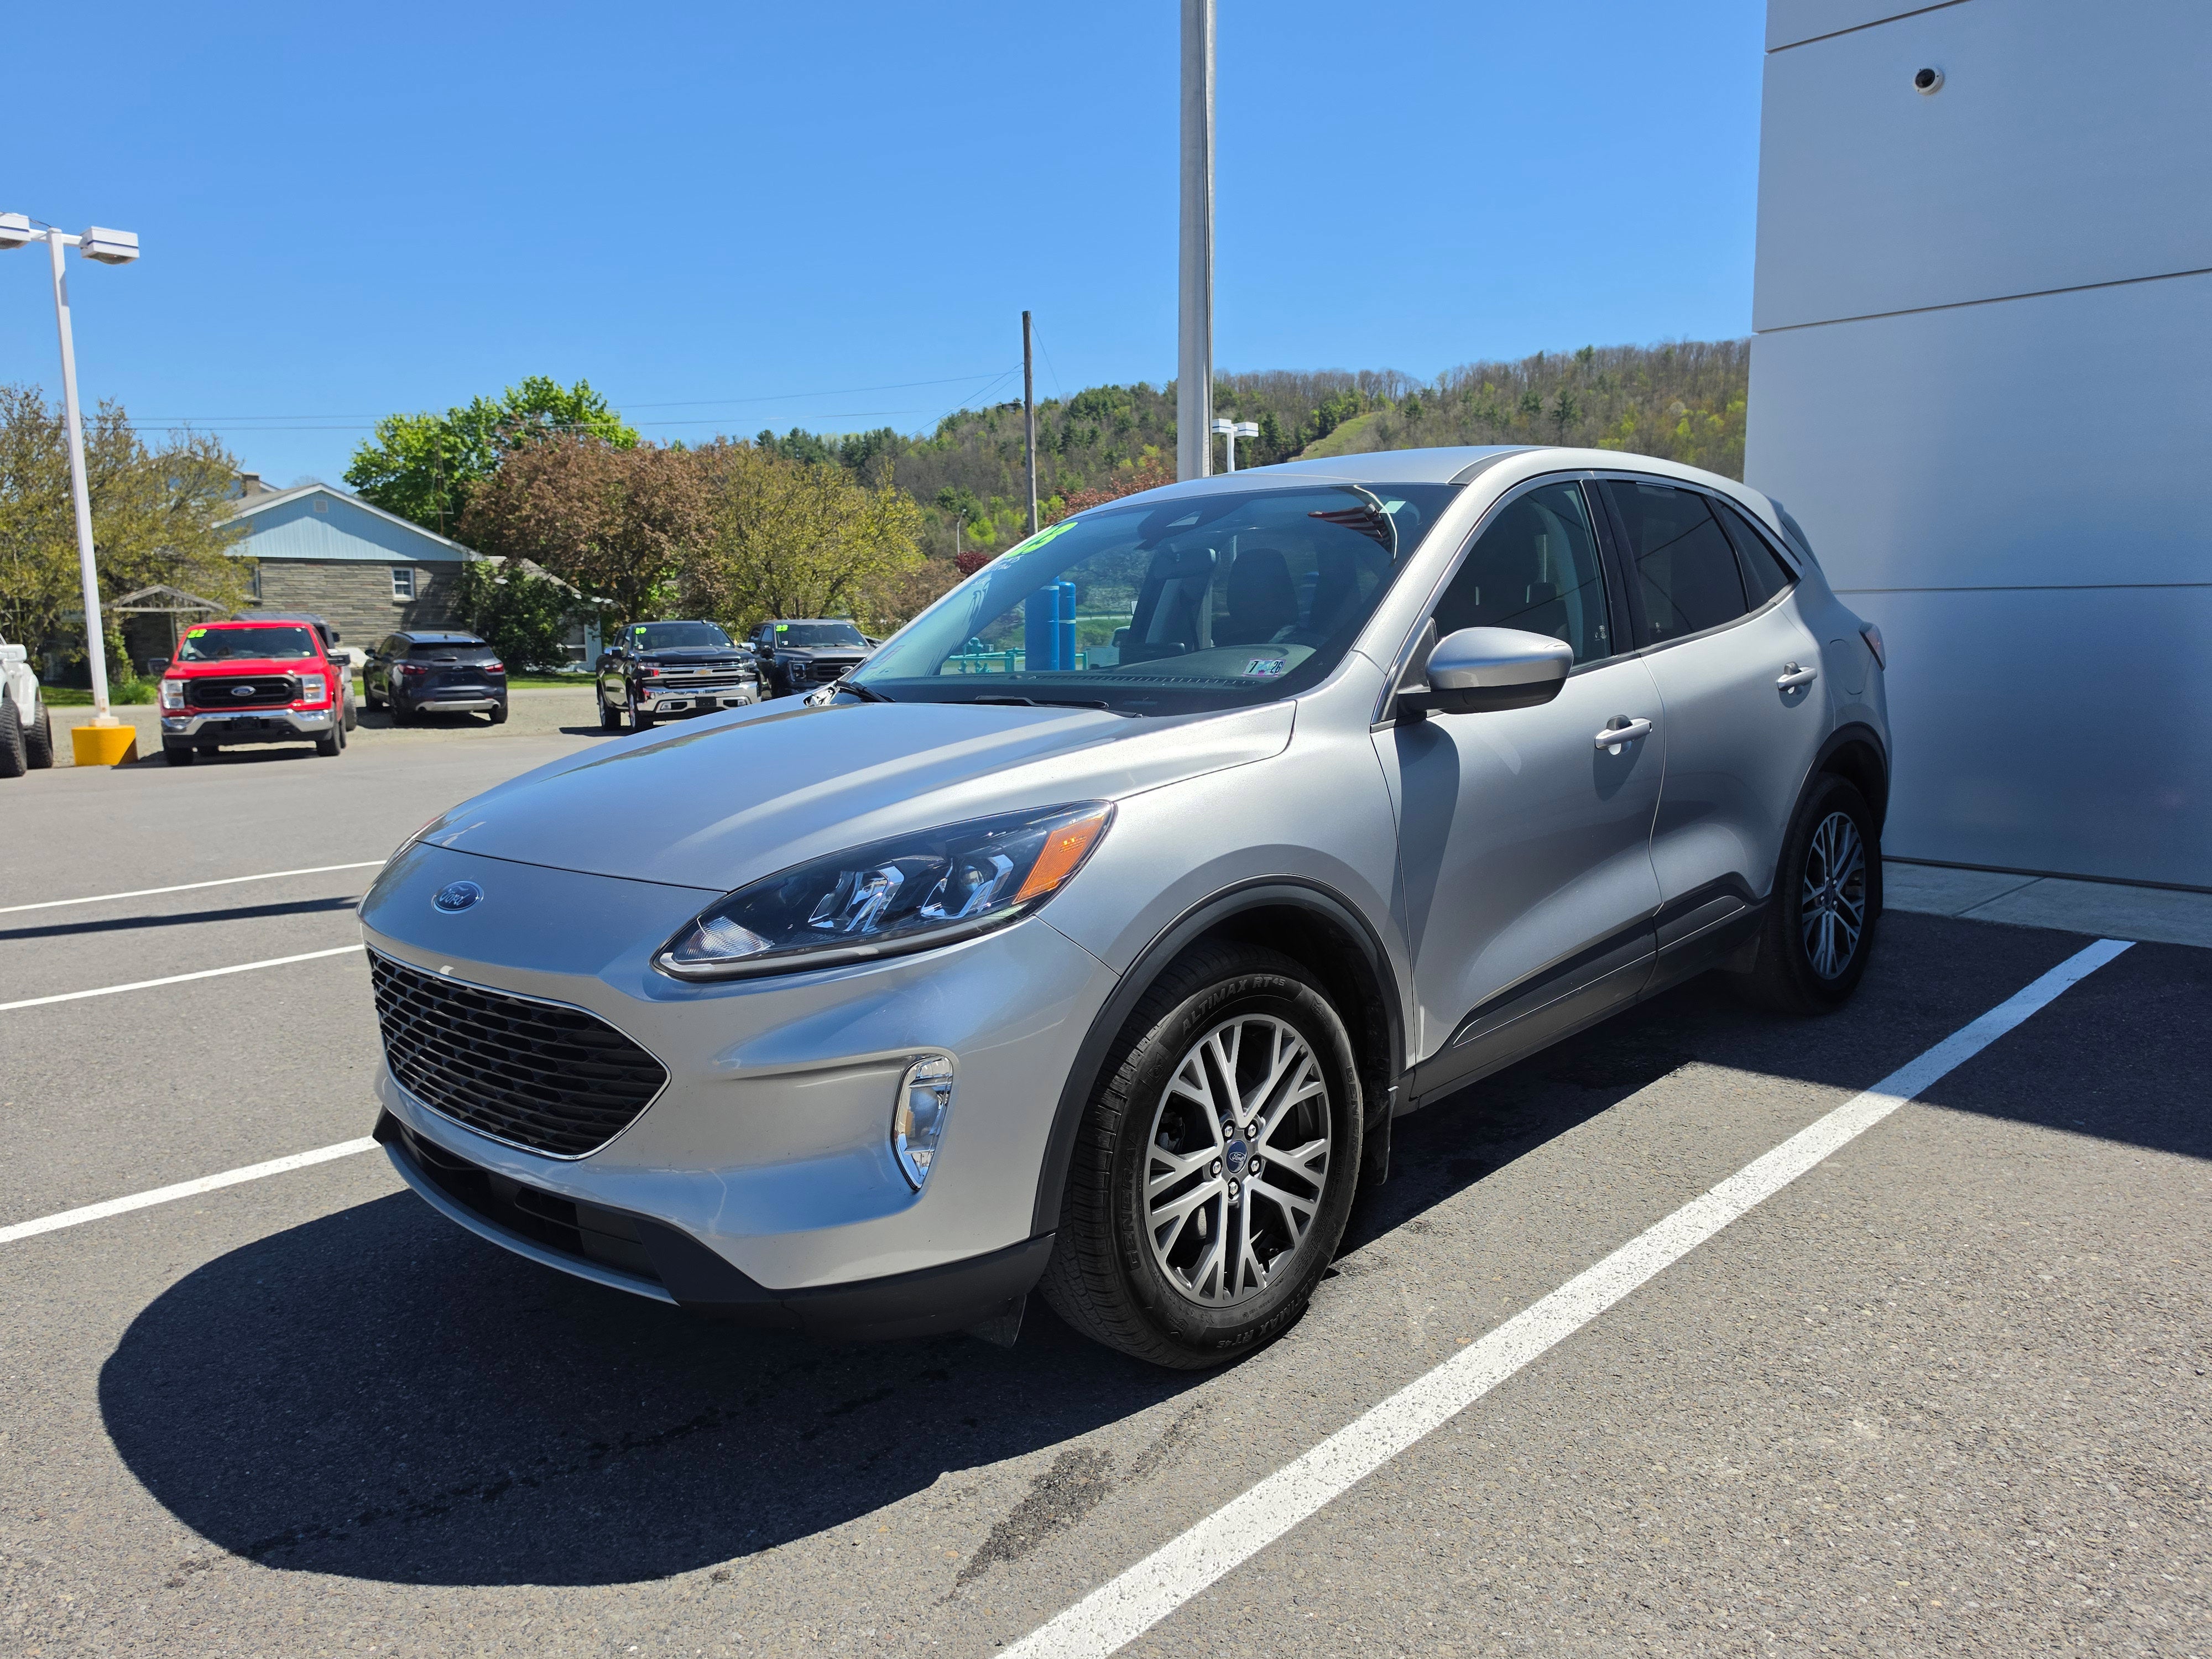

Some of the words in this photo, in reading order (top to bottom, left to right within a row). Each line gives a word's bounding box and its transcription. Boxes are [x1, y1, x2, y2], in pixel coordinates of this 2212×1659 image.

[1004, 522, 1078, 559] 23
[1249, 661, 1259, 672] 7
[1270, 661, 1284, 674] 26
[439, 885, 471, 906] Ford
[1182, 979, 1248, 1035] ALTIMAX
